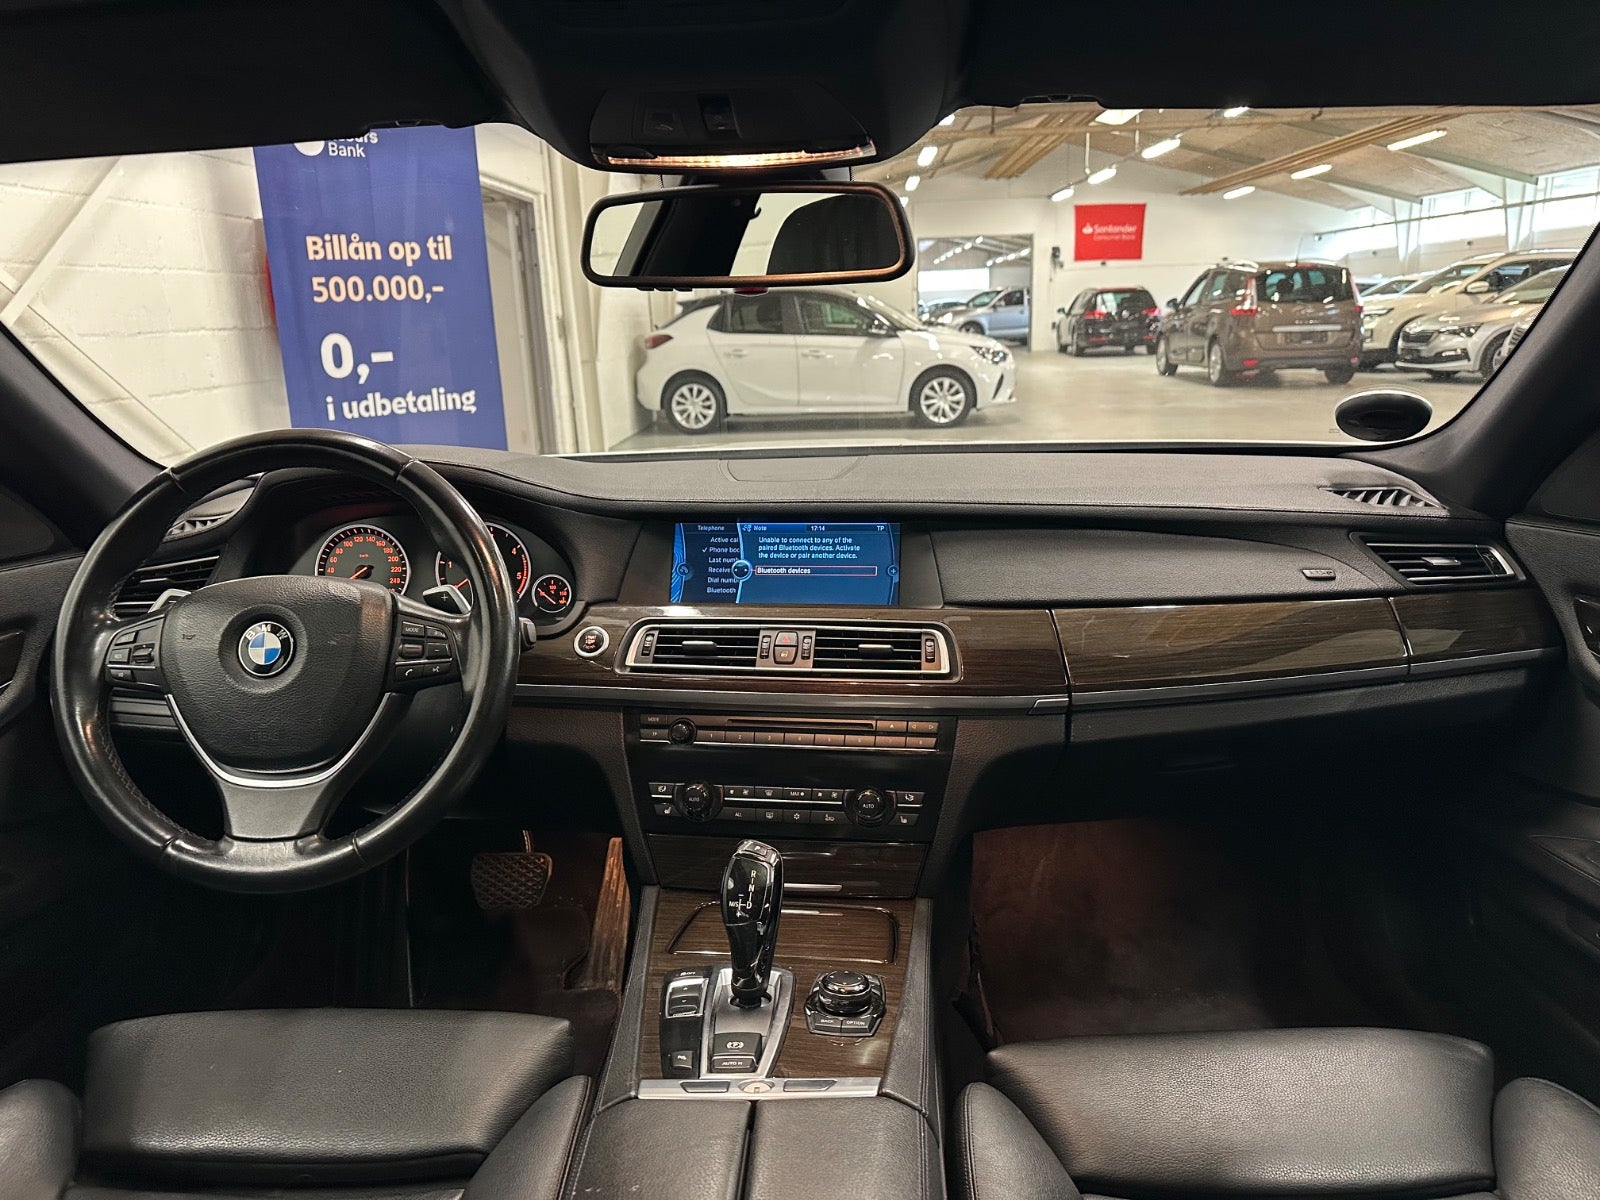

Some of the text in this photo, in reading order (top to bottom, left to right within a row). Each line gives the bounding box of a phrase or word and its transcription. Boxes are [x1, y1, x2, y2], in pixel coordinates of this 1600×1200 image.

[328, 141, 365, 158] Bank
[306, 233, 452, 267] Billån op til
[312, 275, 444, 304] 500.000,-
[321, 333, 393, 384] 0,-
[326, 387, 477, 421] i udbetaling
[511, 547, 517, 555] 4
[516, 572, 522, 580] 5
[245, 624, 288, 640] BMW
[751, 870, 756, 878] R
[748, 884, 755, 892] N
[746, 901, 752, 909] D
